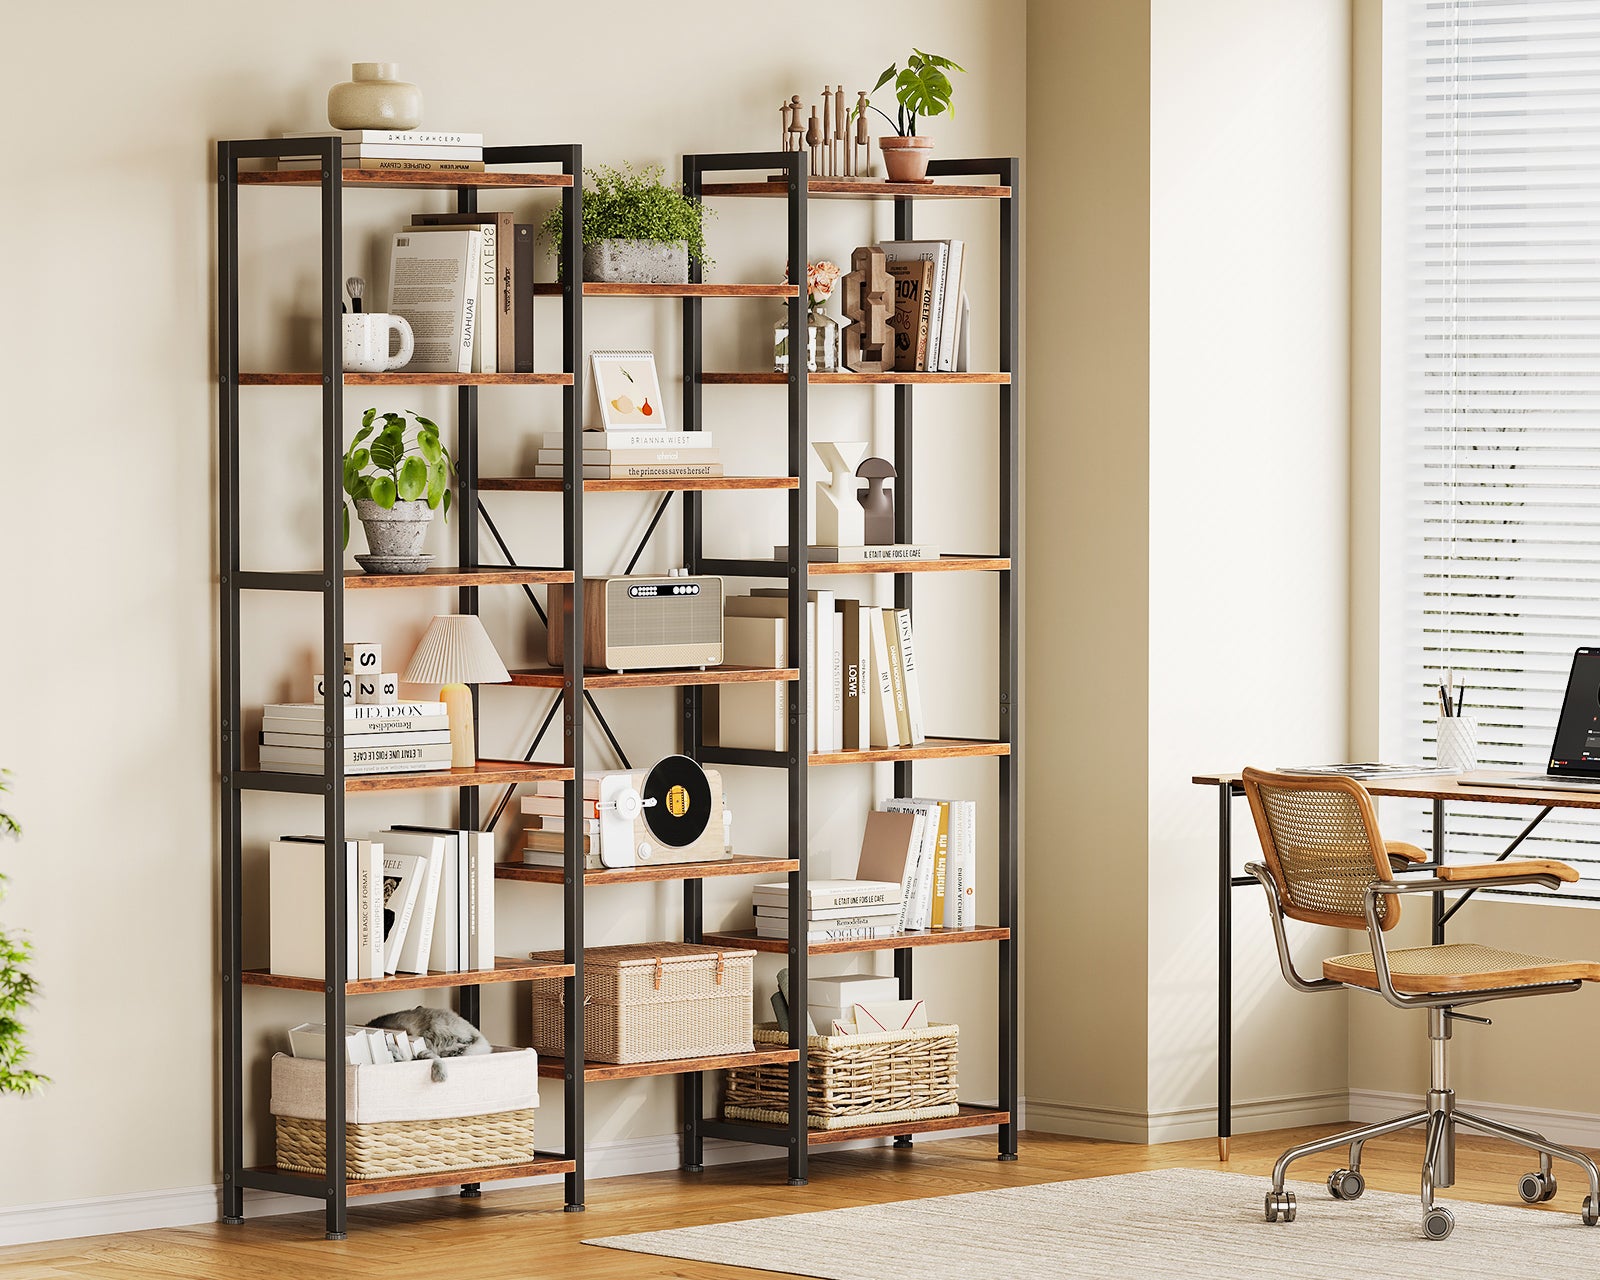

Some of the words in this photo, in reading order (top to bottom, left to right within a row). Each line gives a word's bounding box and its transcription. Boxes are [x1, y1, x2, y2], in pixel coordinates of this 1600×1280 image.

[631, 436, 665, 445] BRIANNA
[668, 436, 690, 444] WIEST
[848, 664, 858, 698] LOEWE
[368, 721, 412, 731] Remodelista
[362, 900, 368, 910] OF
